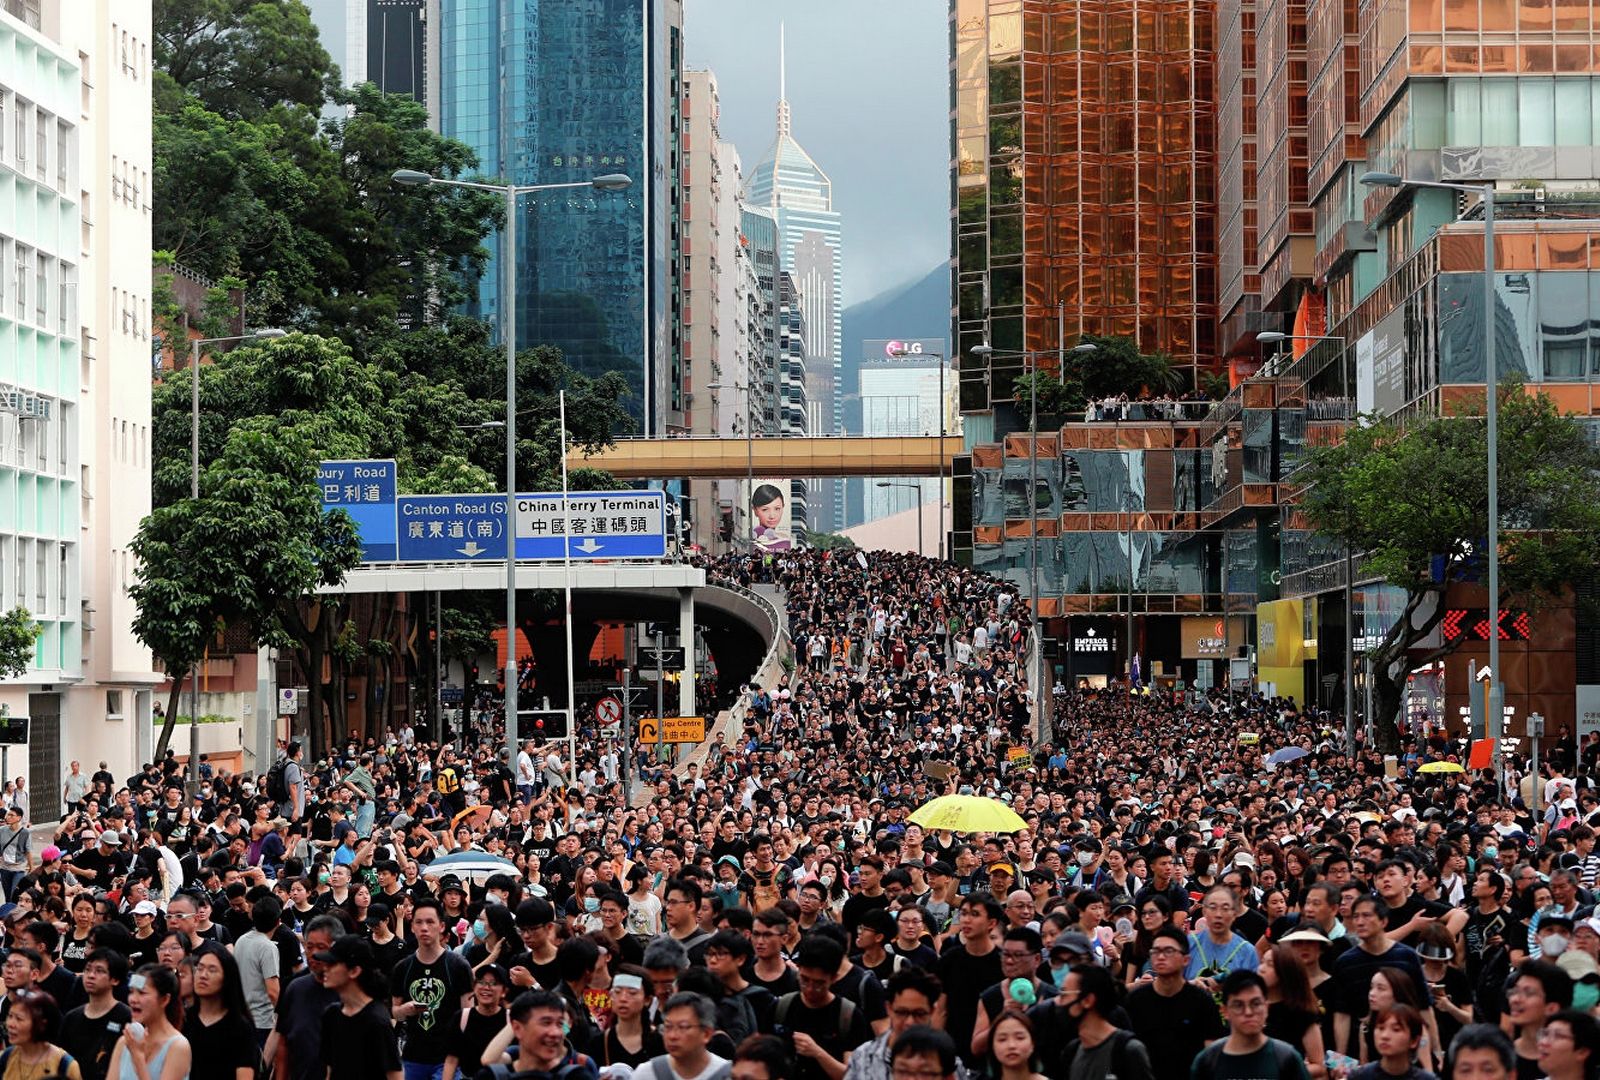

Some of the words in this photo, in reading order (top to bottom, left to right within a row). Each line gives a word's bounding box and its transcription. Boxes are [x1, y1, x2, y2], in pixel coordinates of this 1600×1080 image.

[903, 342, 922, 354] LG
[314, 467, 345, 480] bury
[354, 466, 387, 478] Road
[324, 484, 380, 502] 巴利道
[403, 503, 450, 515] Canton
[455, 503, 487, 515] Road
[490, 502, 508, 515] (S)
[518, 501, 557, 512] China
[601, 499, 660, 511] Terminal
[531, 516, 648, 535] 中國客運碼頭
[421, 978, 433, 989] 34
